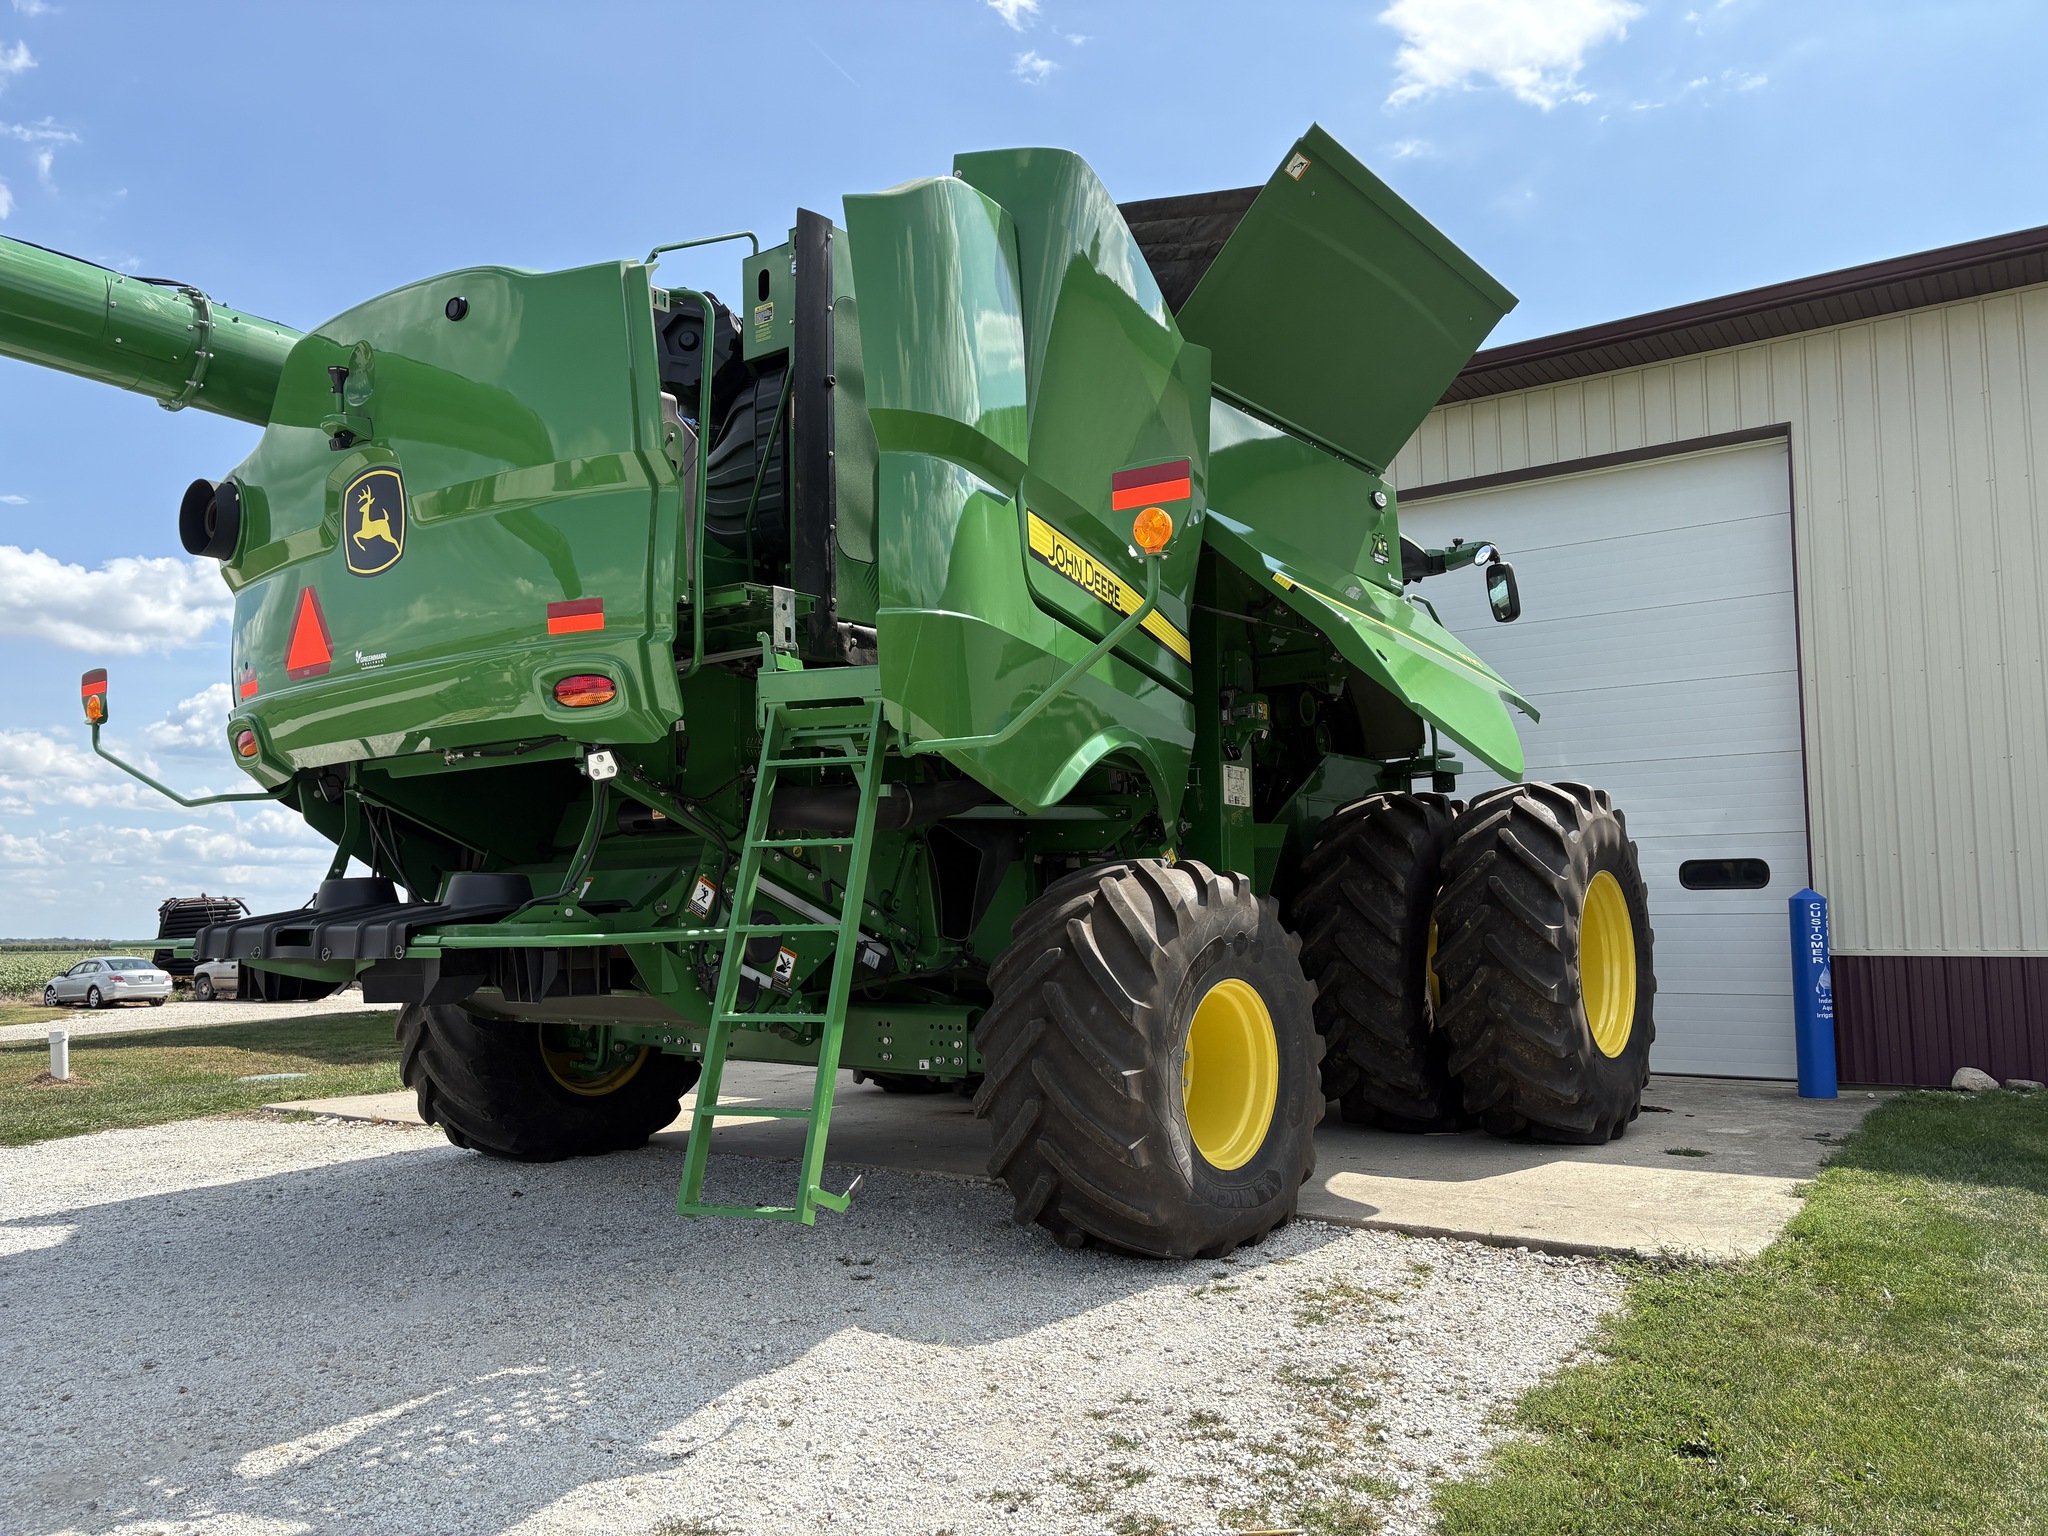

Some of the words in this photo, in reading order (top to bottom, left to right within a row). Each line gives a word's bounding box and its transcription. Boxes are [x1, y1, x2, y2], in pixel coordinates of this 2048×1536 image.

[1047, 534, 1083, 586] JOHN
[1084, 557, 1122, 610] DEERE
[1809, 902, 1824, 964] CUSTOMER
